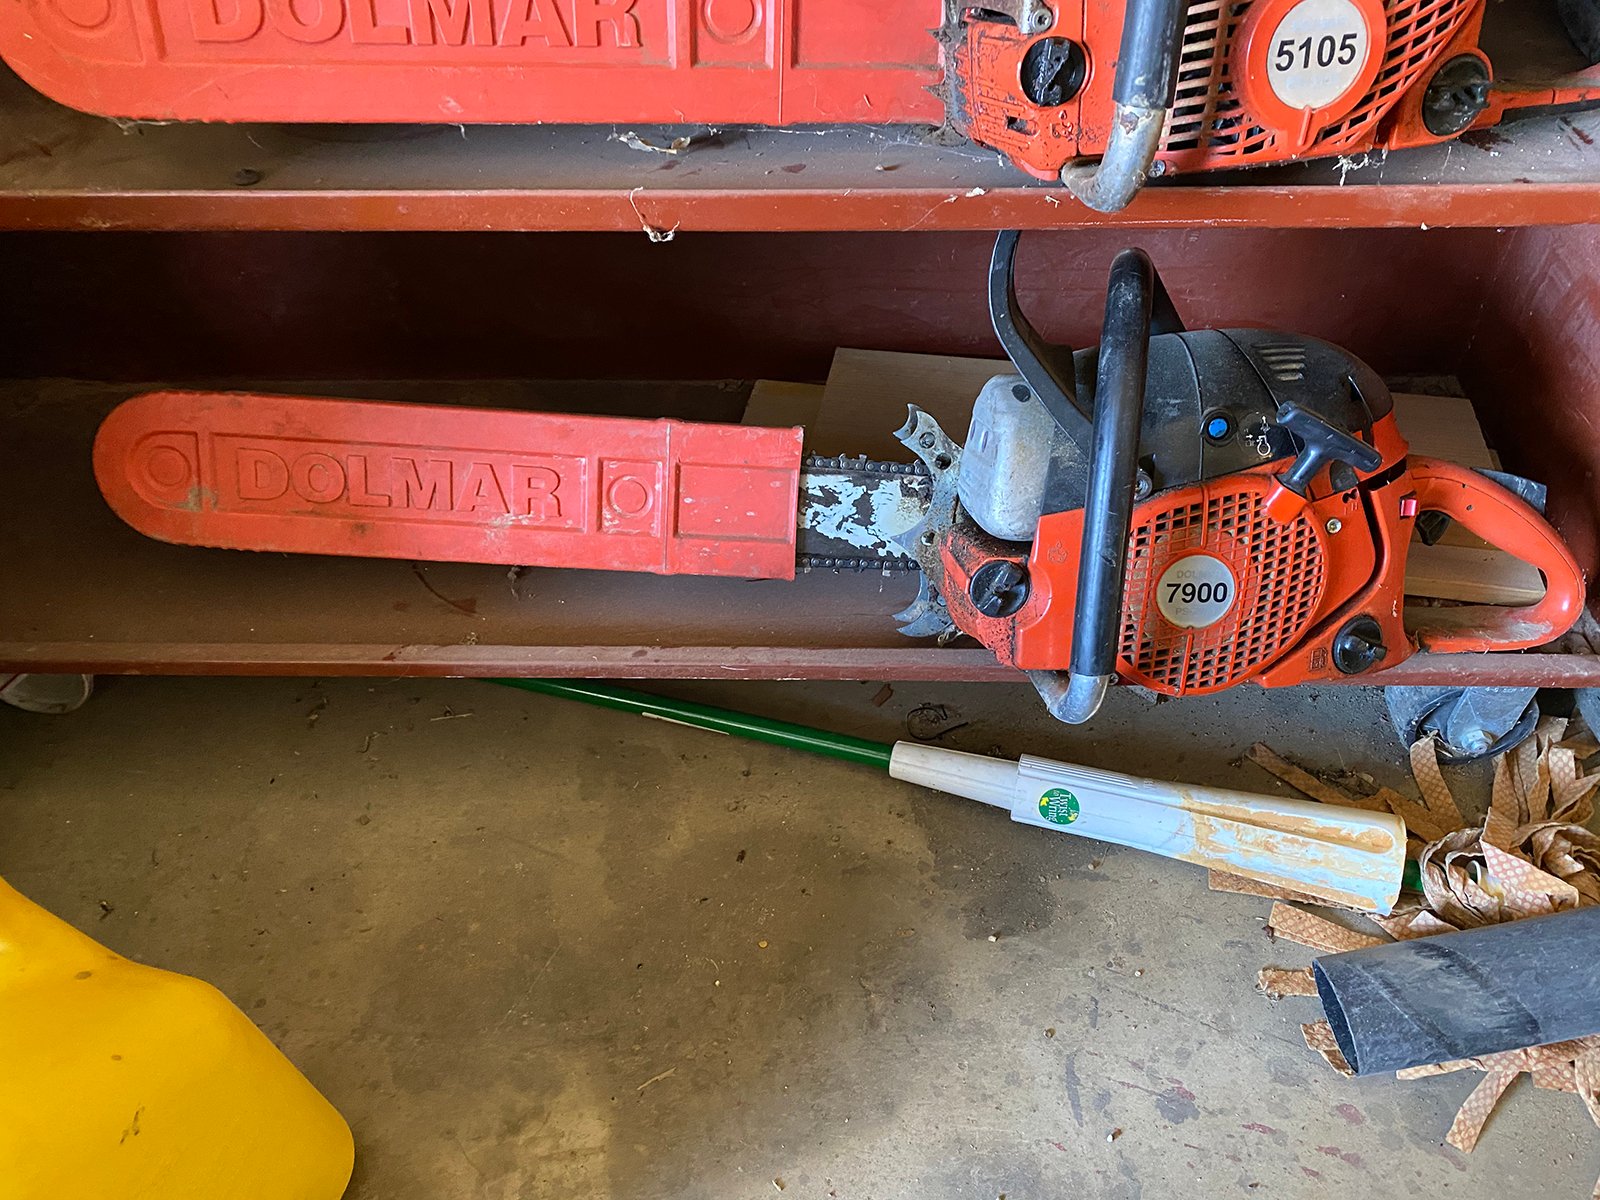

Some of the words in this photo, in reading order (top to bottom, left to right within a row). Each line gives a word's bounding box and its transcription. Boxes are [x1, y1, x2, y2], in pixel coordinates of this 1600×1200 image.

[1275, 33, 1357, 71] 5105
[237, 447, 563, 517] DOLMAR
[1166, 582, 1228, 603] 7900
[1058, 793, 1072, 817] Twist
